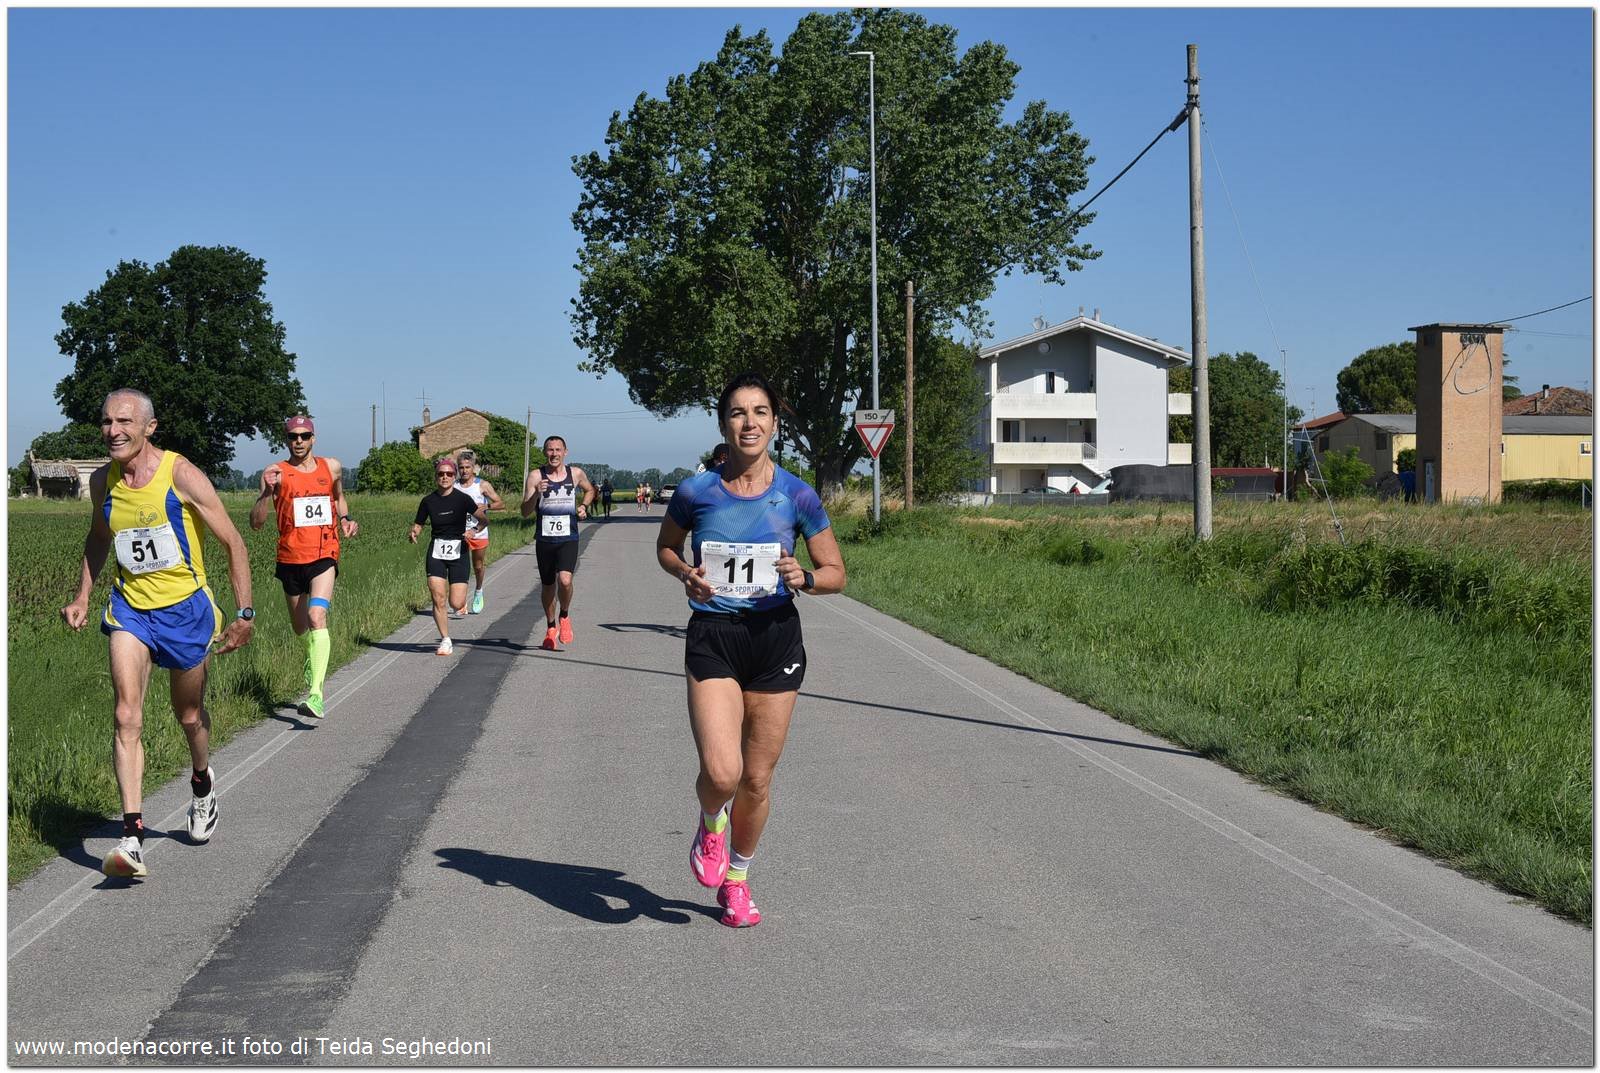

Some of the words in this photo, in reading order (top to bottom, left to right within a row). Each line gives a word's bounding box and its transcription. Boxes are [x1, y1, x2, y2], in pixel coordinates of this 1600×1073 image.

[305, 504, 323, 519] 84
[549, 521, 563, 531] 76
[131, 539, 159, 562] 51
[440, 544, 453, 555] 12
[724, 557, 754, 584] 11
